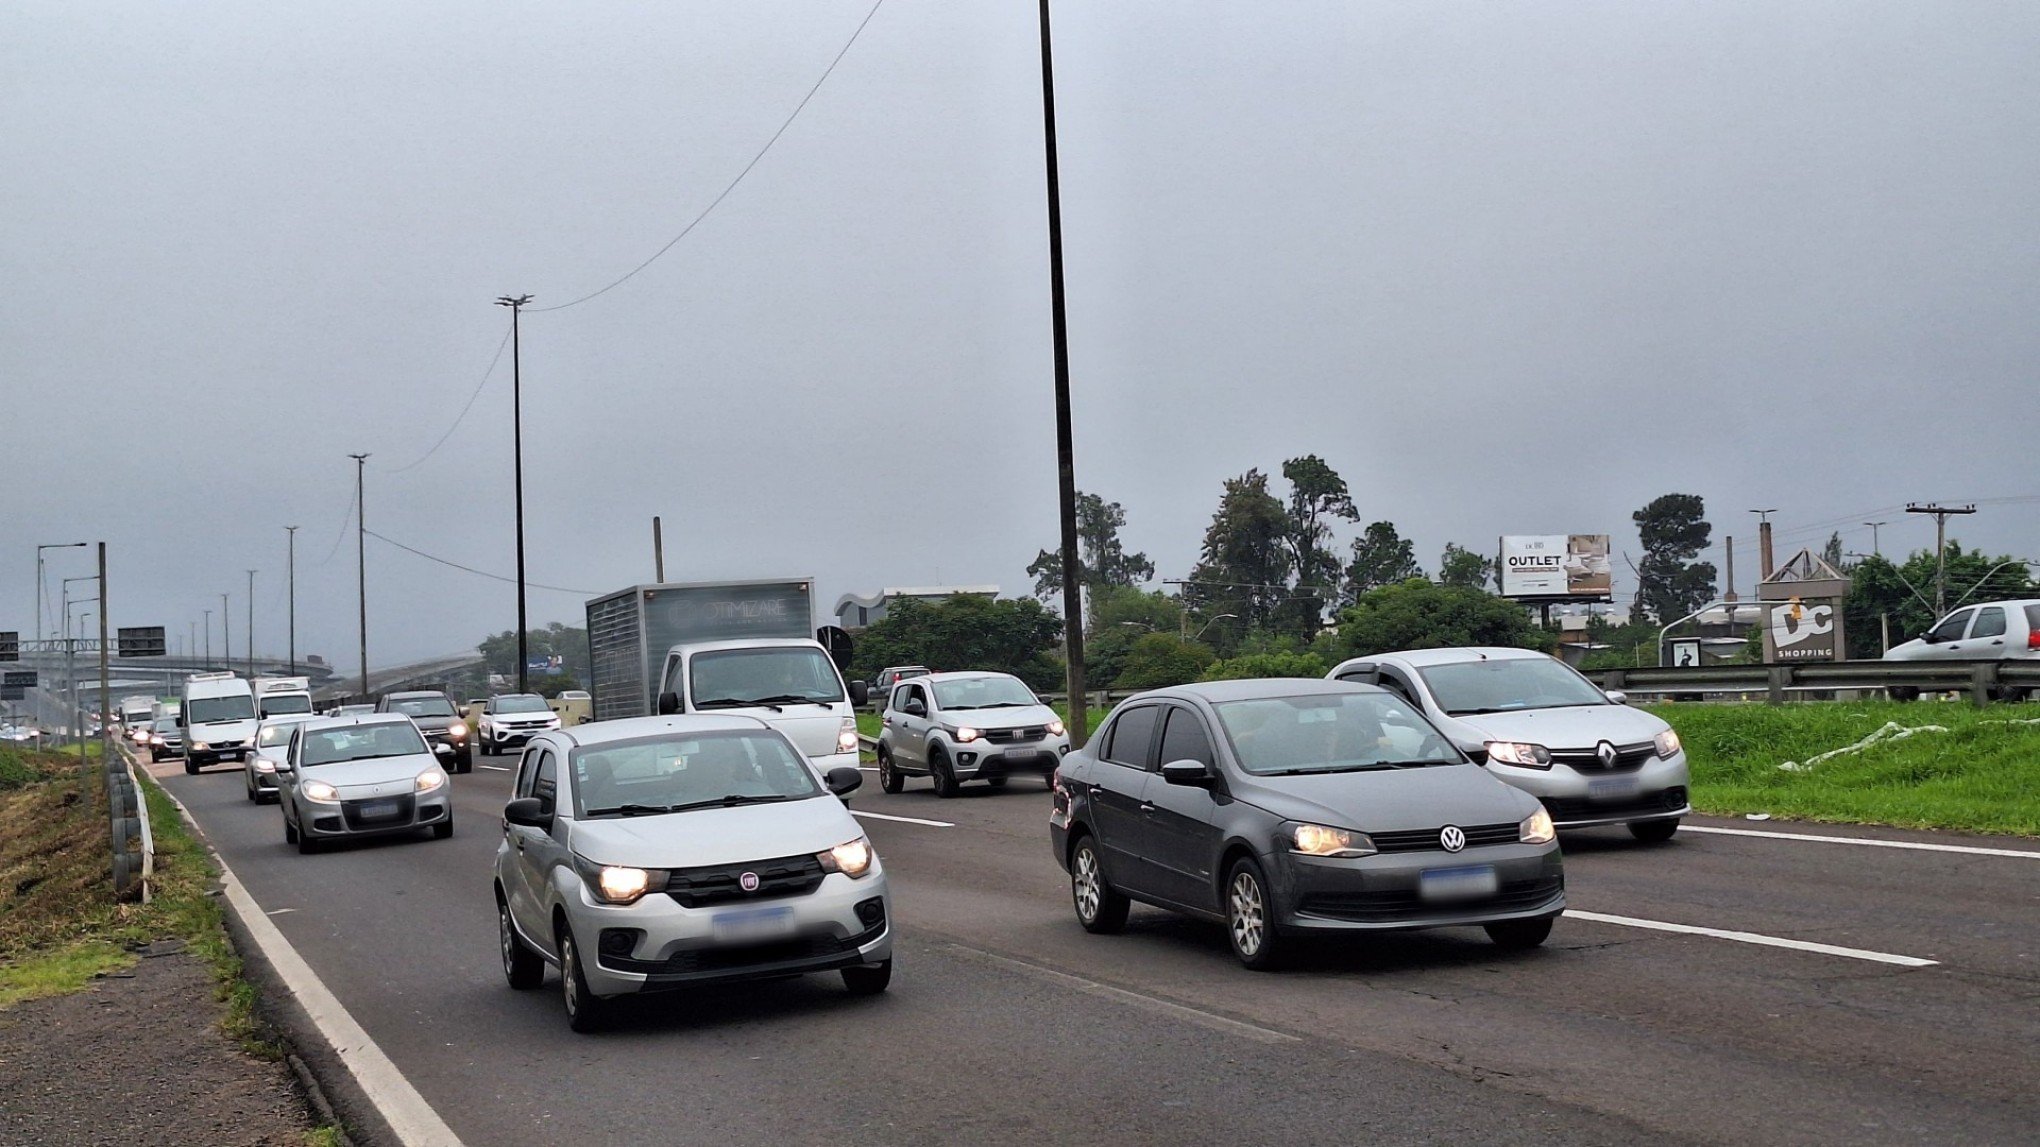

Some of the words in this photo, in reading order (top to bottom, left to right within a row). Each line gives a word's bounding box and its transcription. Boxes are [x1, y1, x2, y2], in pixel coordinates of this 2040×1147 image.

[1508, 555, 1562, 566] OUTLET
[1771, 604, 1833, 648] DC
[1778, 648, 1832, 658] SHOPPING
